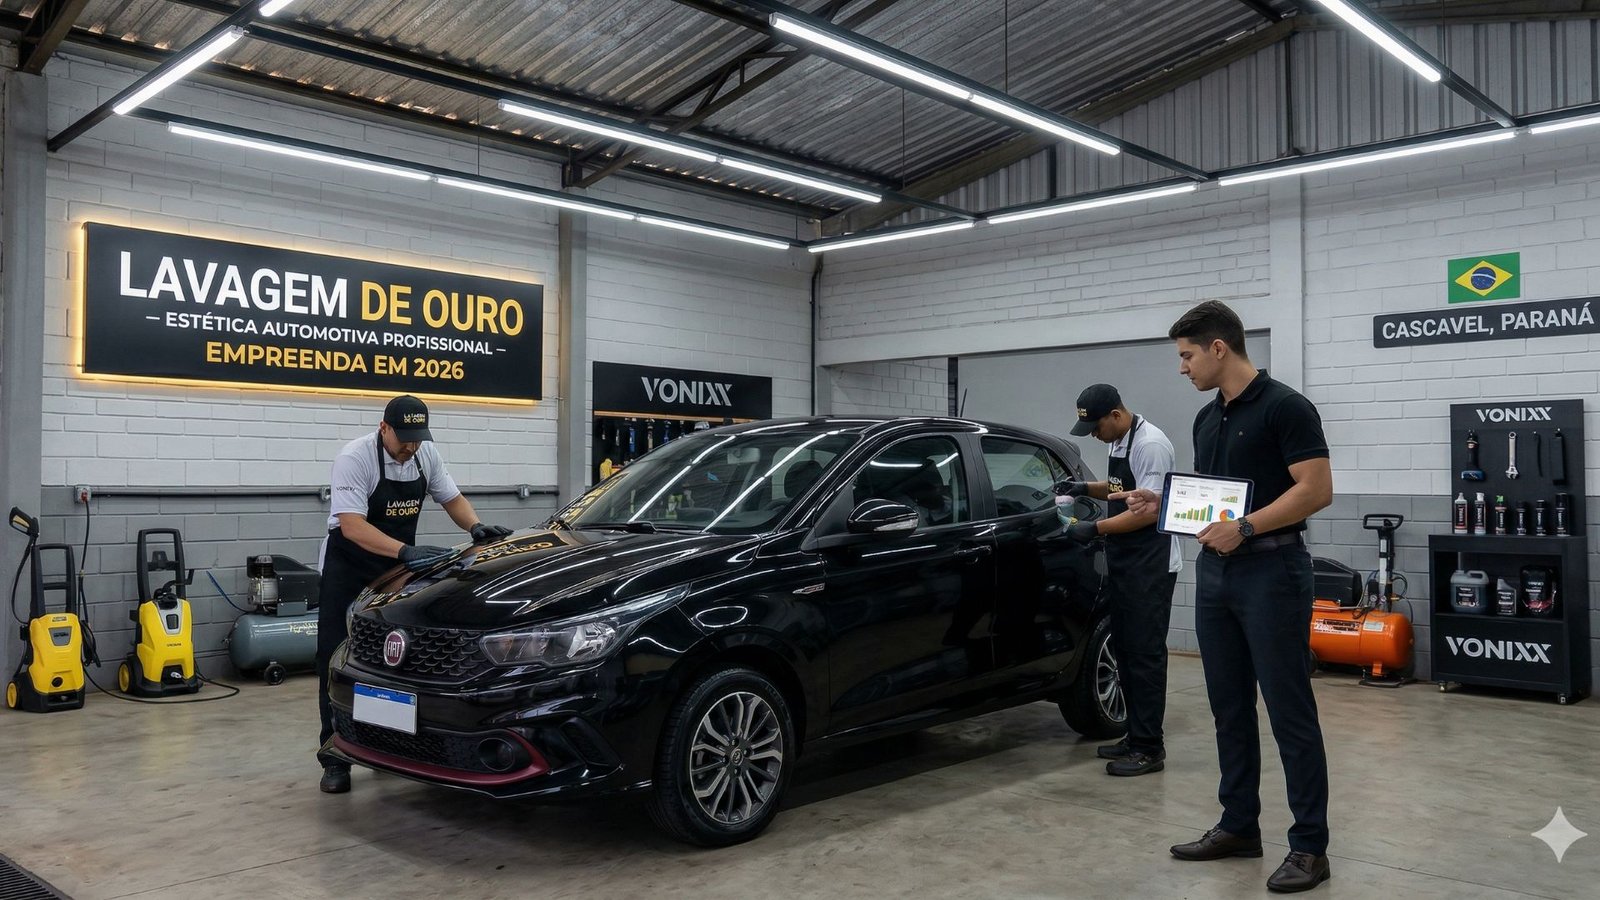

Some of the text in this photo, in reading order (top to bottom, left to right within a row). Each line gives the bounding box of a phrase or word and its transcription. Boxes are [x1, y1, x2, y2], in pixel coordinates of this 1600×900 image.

[119, 251, 524, 336] LAVAGEM DE OURO
[165, 310, 493, 355] ESTÉTICA AUTOMOTIVA PROFISSIONAL
[1382, 302, 1595, 339] CASCAVEL, PARANÁ
[206, 341, 465, 380] EMPREENDA EM 2026
[641, 376, 733, 406] VONIXX
[1476, 407, 1552, 422] VONIXX
[386, 506, 419, 516] DE OURO
[387, 640, 401, 658] FIAT
[1445, 635, 1552, 664] VONIXX
